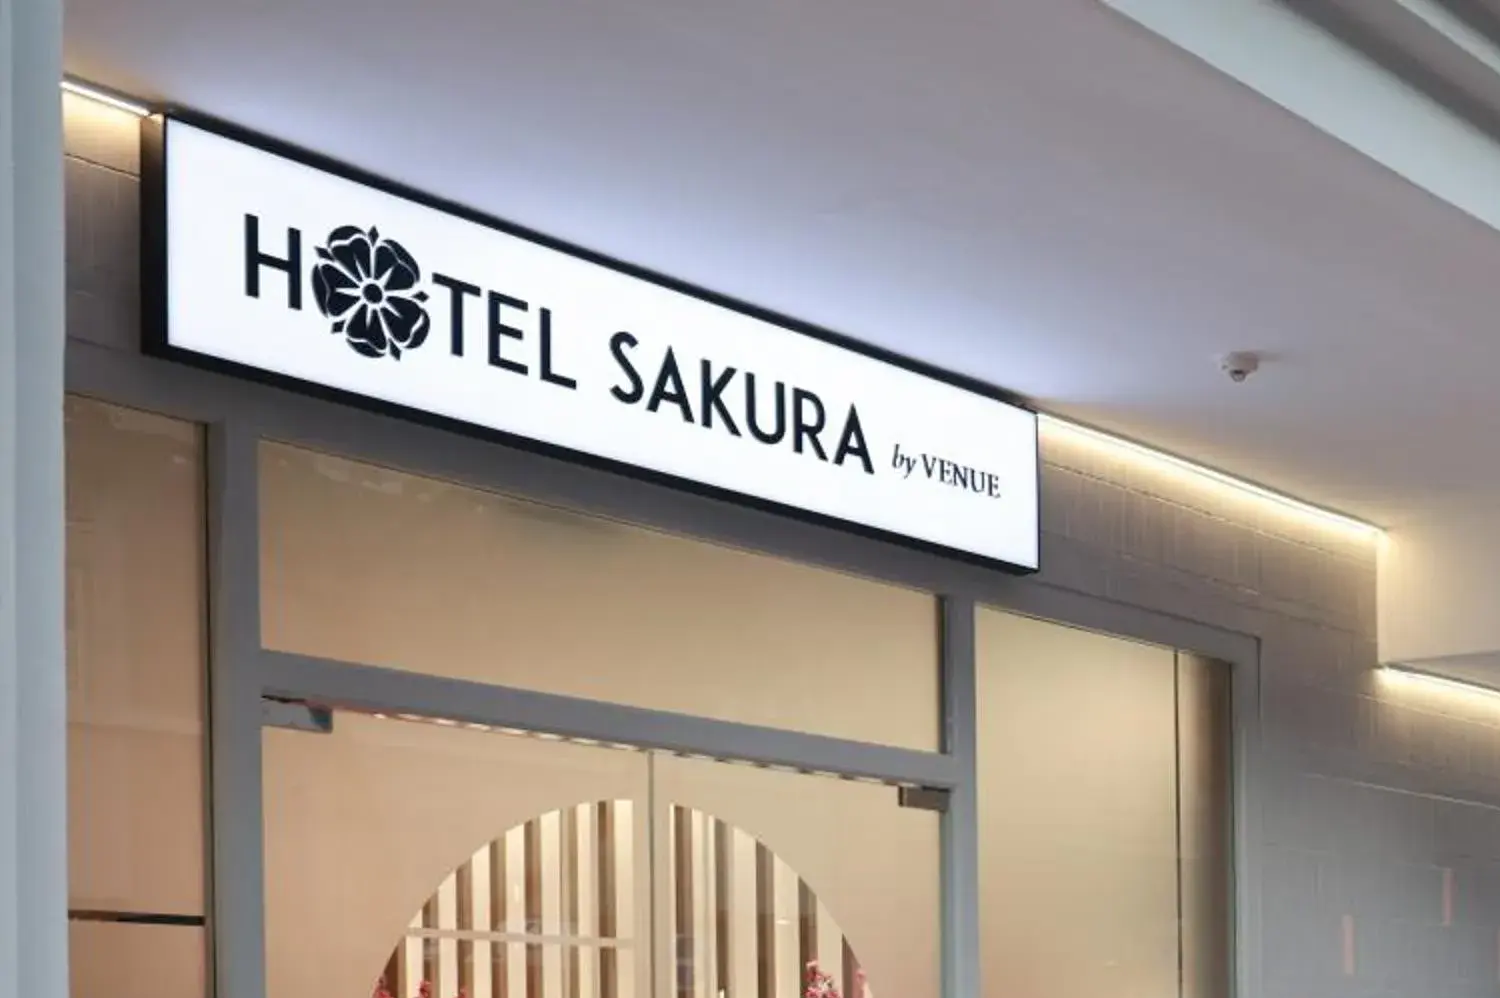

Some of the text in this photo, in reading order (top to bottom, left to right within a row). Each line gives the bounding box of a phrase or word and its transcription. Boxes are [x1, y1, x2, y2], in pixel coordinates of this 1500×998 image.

[608, 330, 875, 475] SAKURA
[891, 443, 917, 480] by
[920, 452, 1001, 499] VENUE
